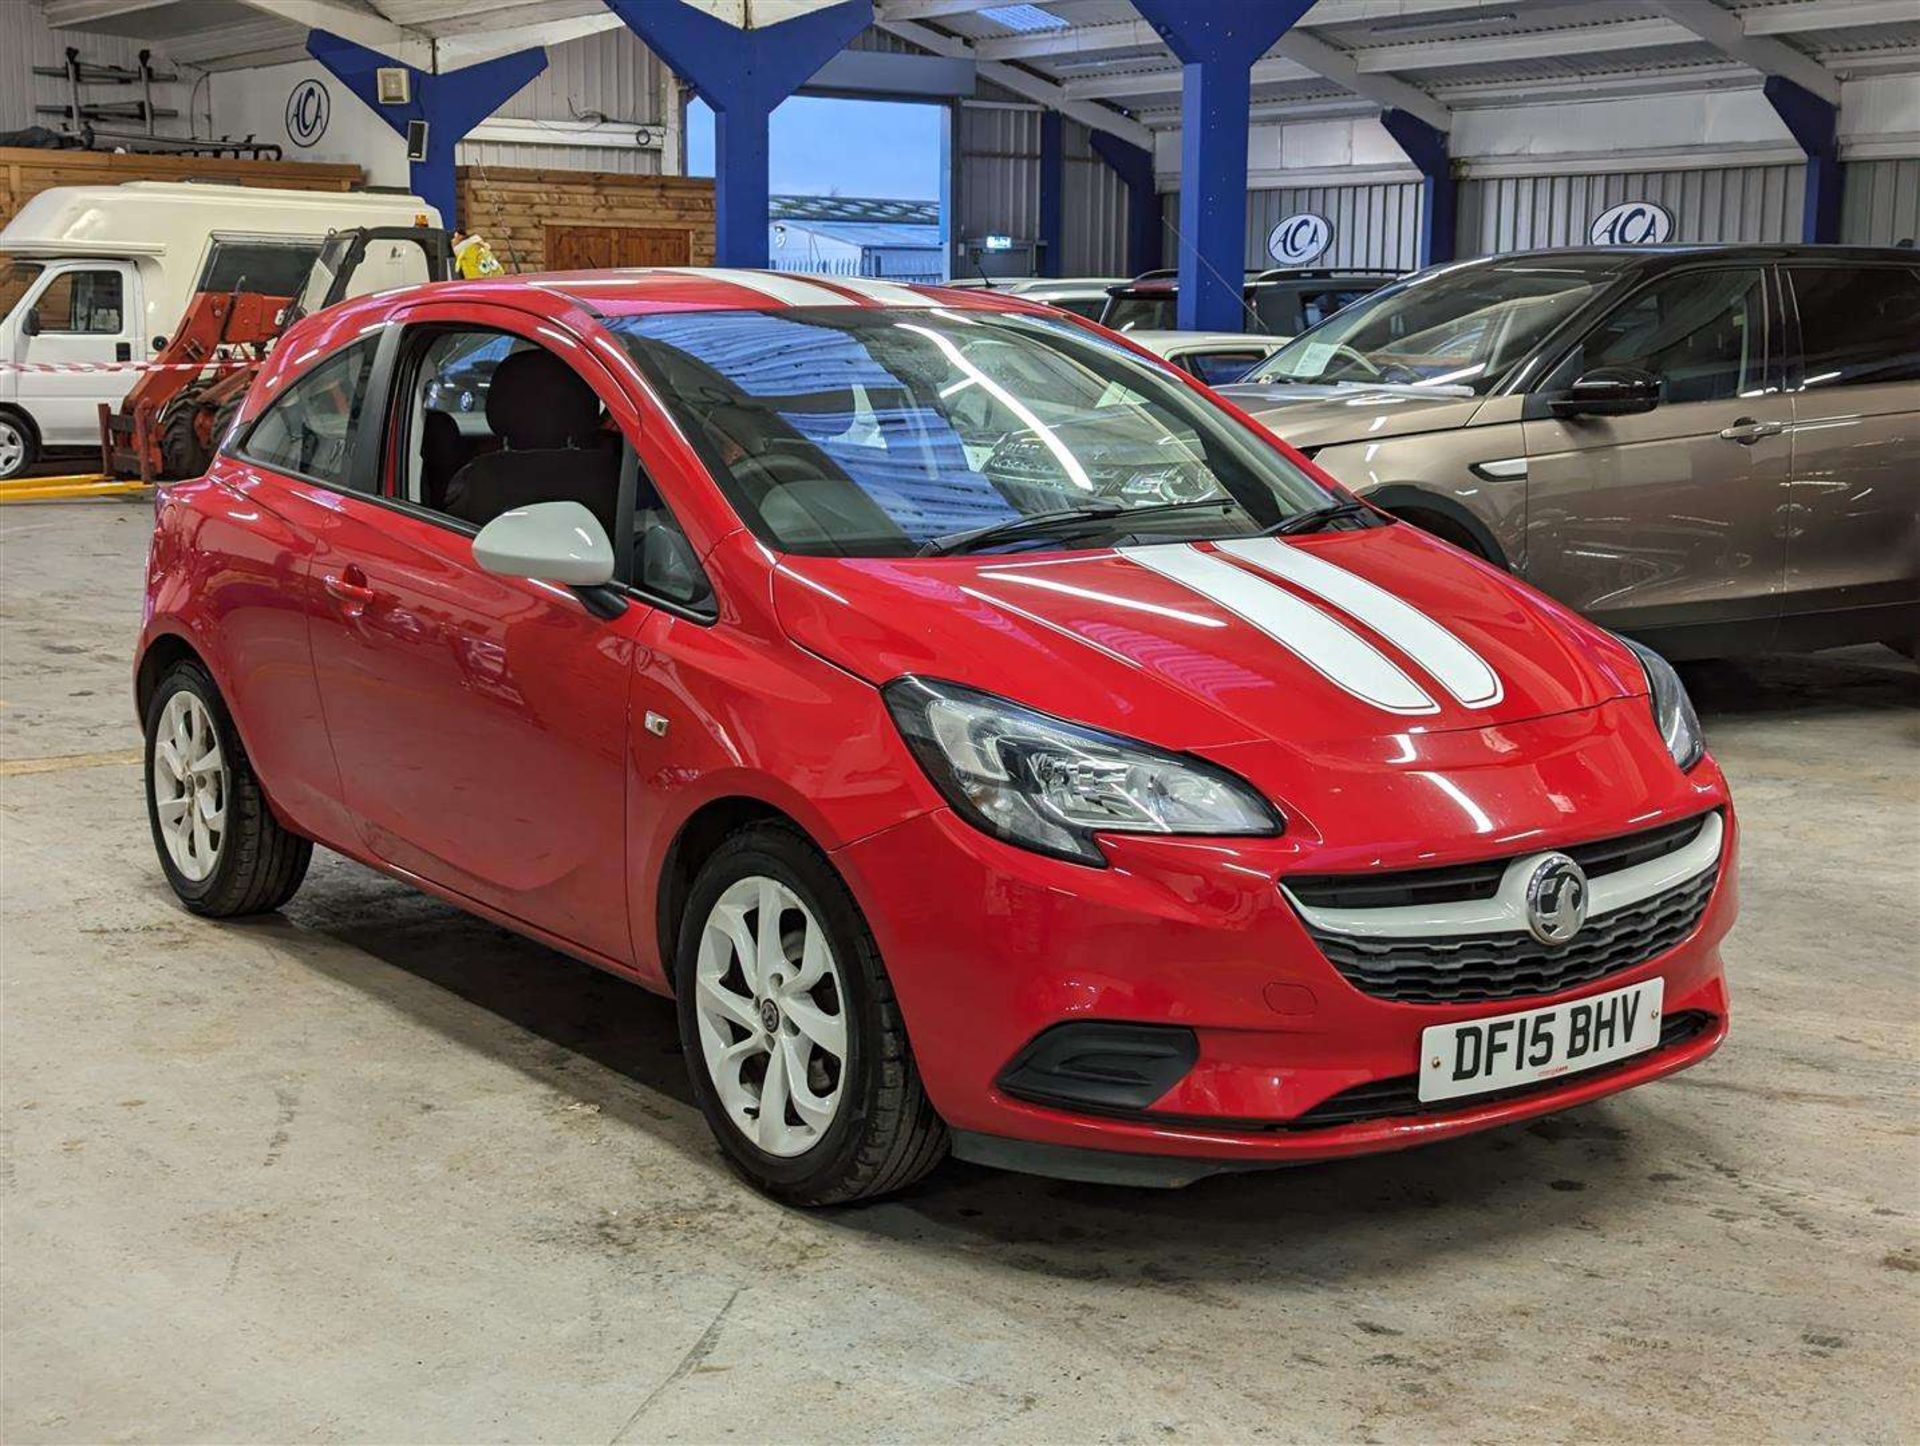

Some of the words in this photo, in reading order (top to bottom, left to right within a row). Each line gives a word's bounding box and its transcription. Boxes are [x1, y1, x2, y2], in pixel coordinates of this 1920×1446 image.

[289, 87, 323, 137] ACA
[1271, 218, 1320, 257] ACA
[1594, 207, 1657, 245] ACA
[1452, 1012, 1556, 1081] DF15
[1566, 990, 1641, 1060] BHV
